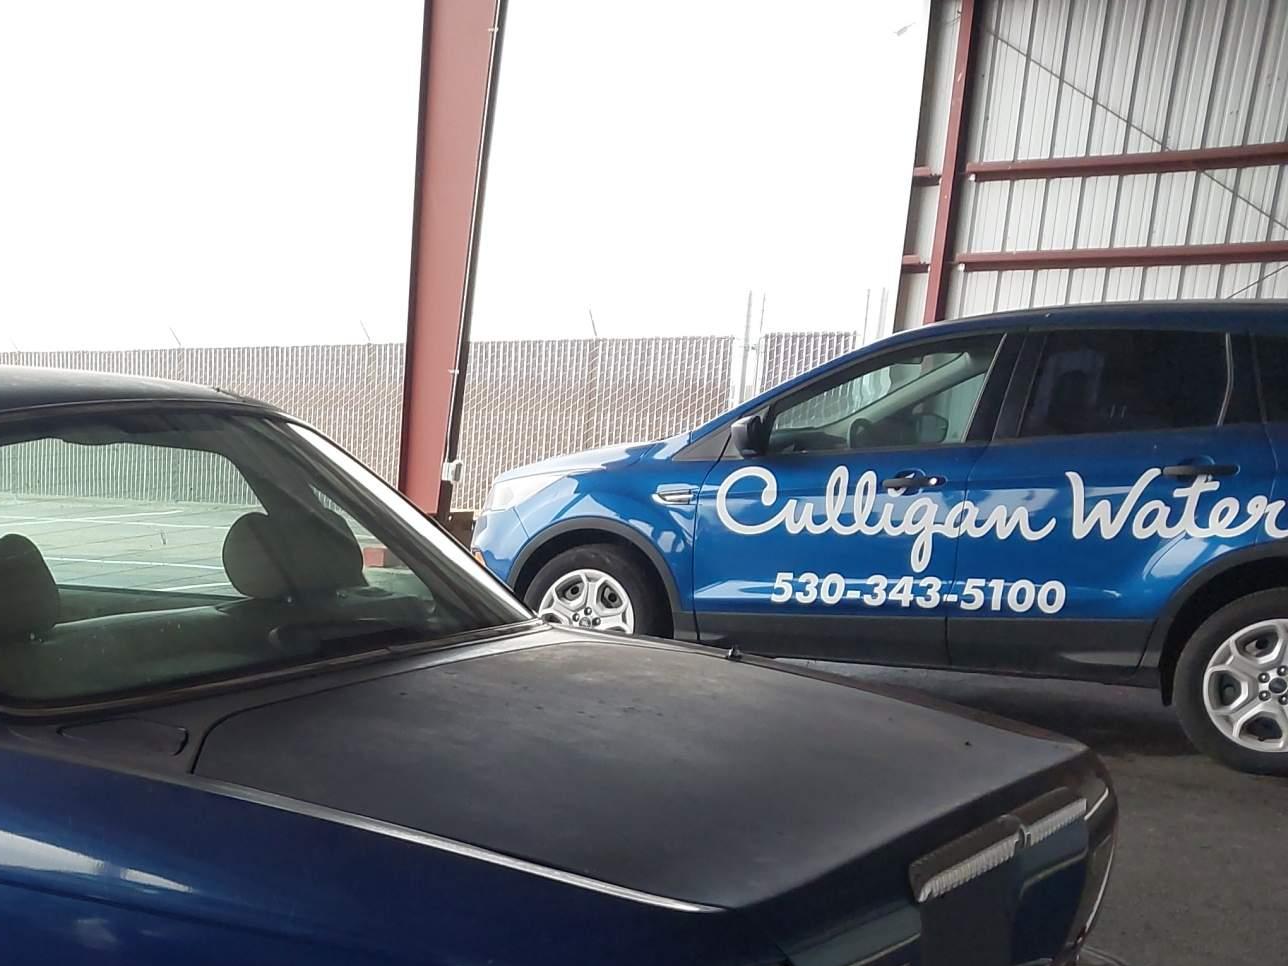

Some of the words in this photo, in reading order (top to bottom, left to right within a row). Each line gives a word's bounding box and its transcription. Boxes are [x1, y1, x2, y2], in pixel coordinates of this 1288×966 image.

[716, 465, 1056, 573] Culligan
[1065, 467, 1288, 540] Water
[770, 571, 1066, 614] 530-343-5100
